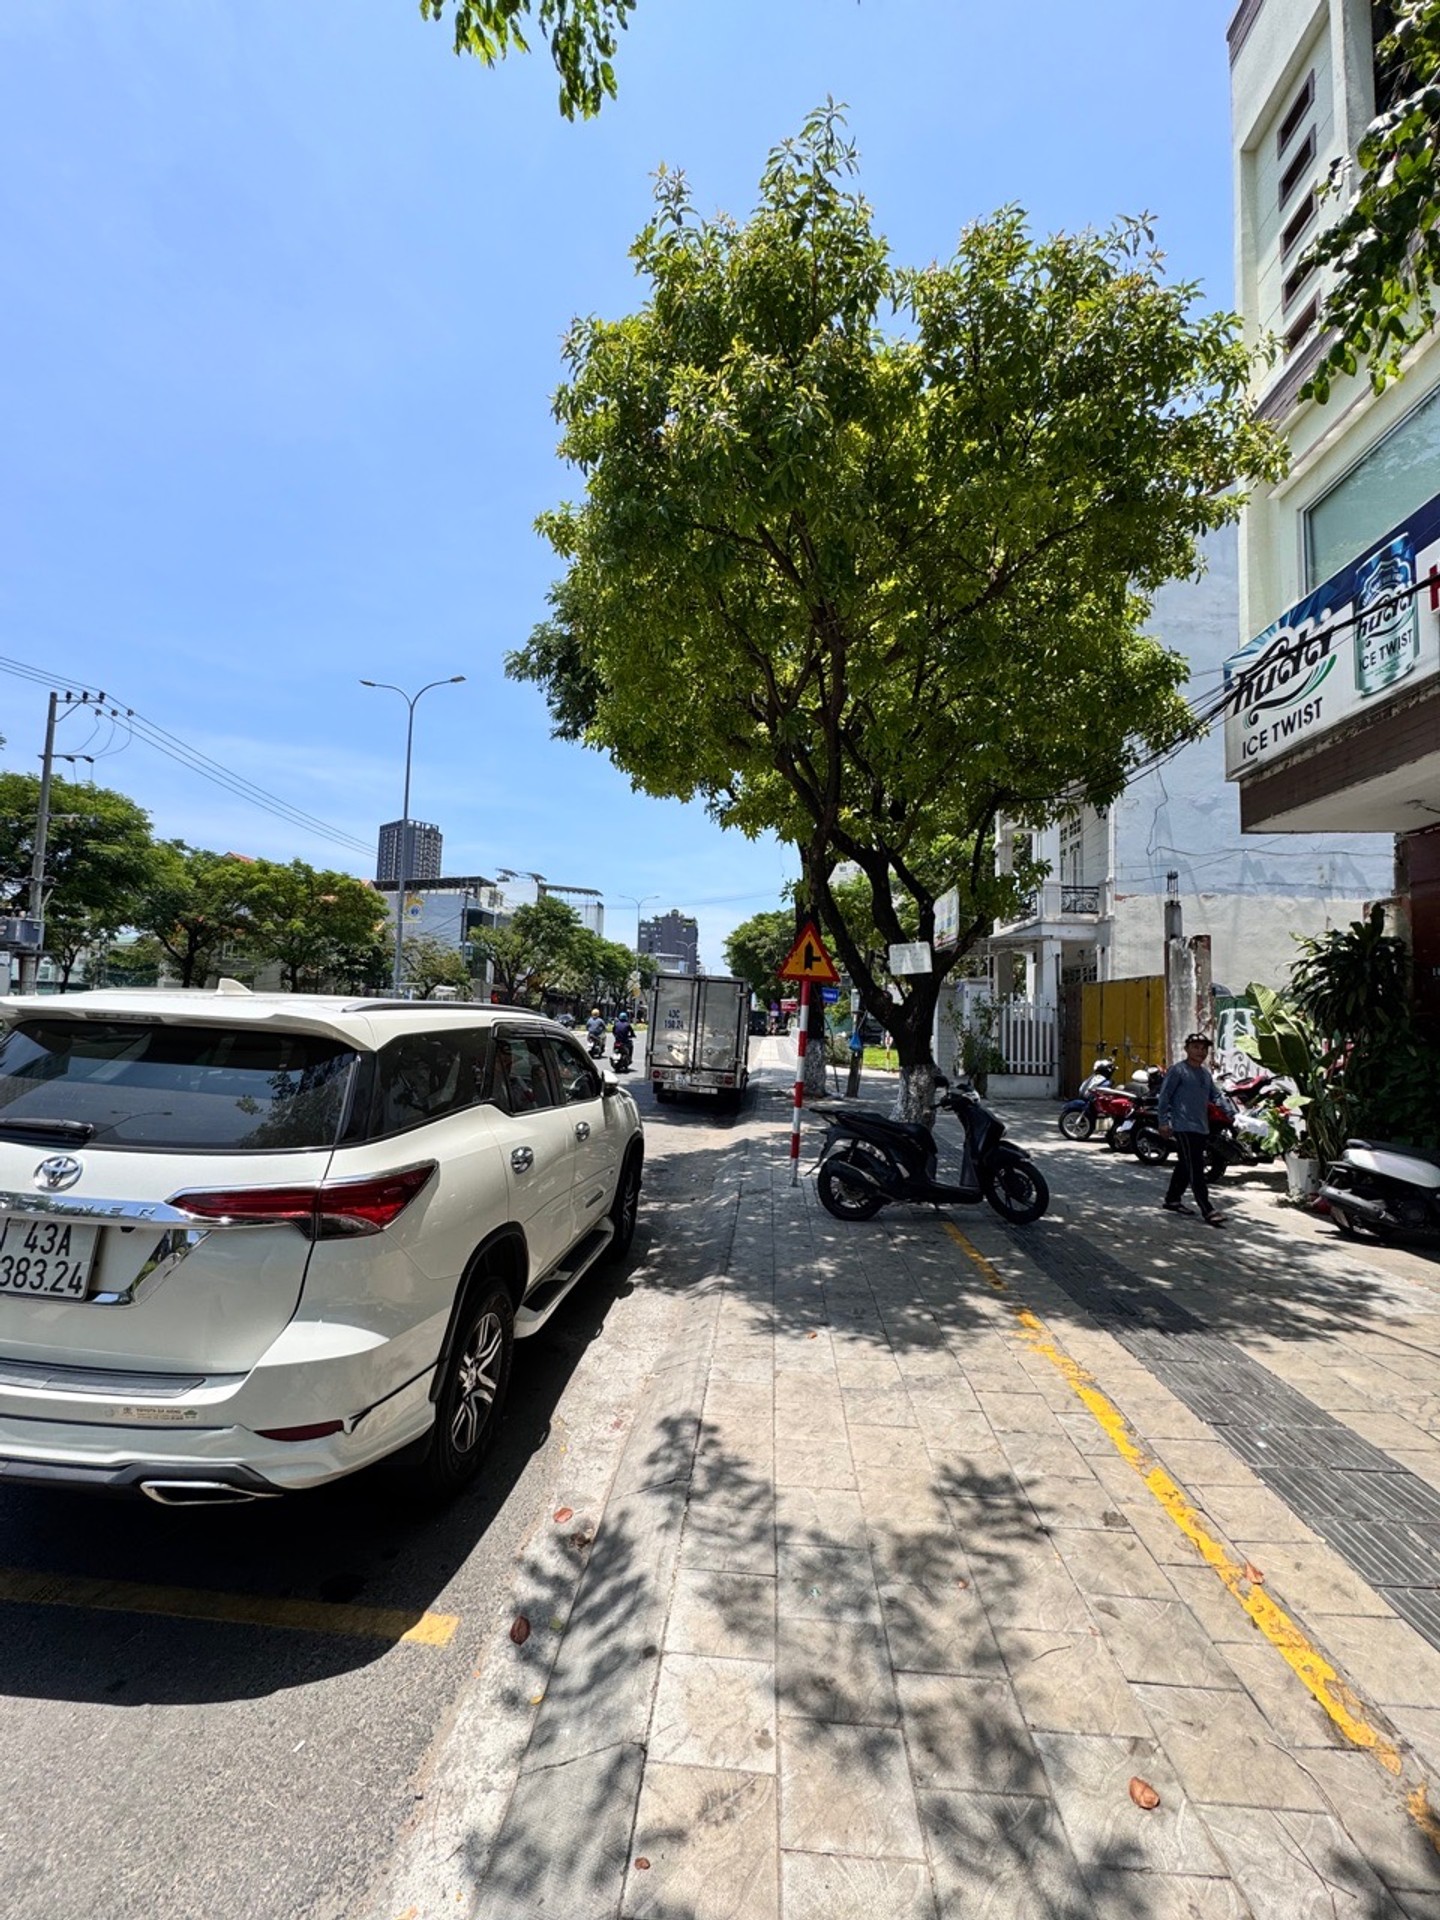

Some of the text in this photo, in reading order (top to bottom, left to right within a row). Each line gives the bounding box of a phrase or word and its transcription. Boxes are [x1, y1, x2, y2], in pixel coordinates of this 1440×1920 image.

[1358, 651, 1377, 672] ICE
[1380, 628, 1413, 661] TWIST
[1242, 696, 1323, 760] ICE TWIST
[24, 1221, 72, 1257] 43A
[0, 1255, 83, 1294] 383.24
